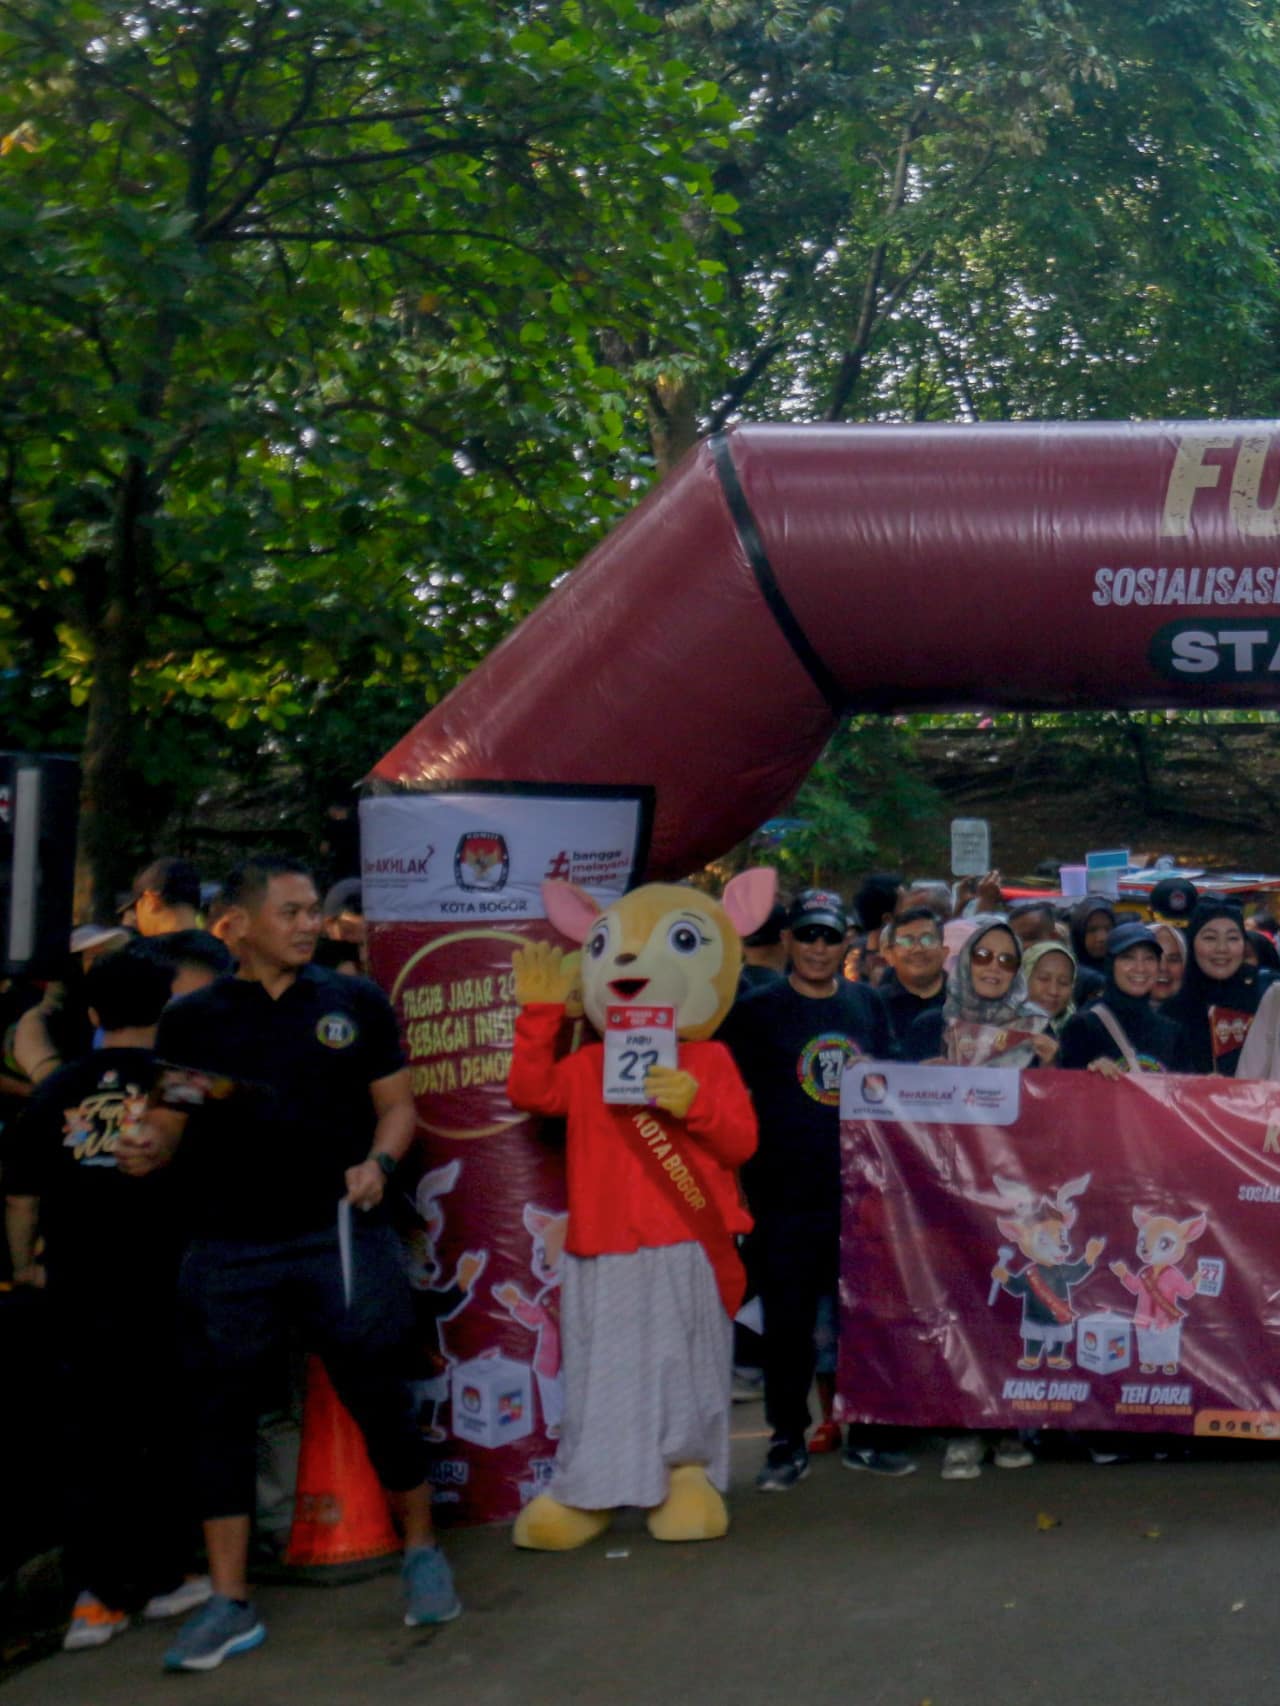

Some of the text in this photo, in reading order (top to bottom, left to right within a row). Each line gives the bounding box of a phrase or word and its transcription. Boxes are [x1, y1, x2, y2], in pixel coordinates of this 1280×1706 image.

[440, 900, 528, 914] KOTA BOGOR
[448, 976, 494, 1012] JABAR
[632, 1110, 707, 1212] KOTA BOGOR
[1002, 1380, 1091, 1402] KANG DARU
[1120, 1384, 1192, 1405] TEH DARA
